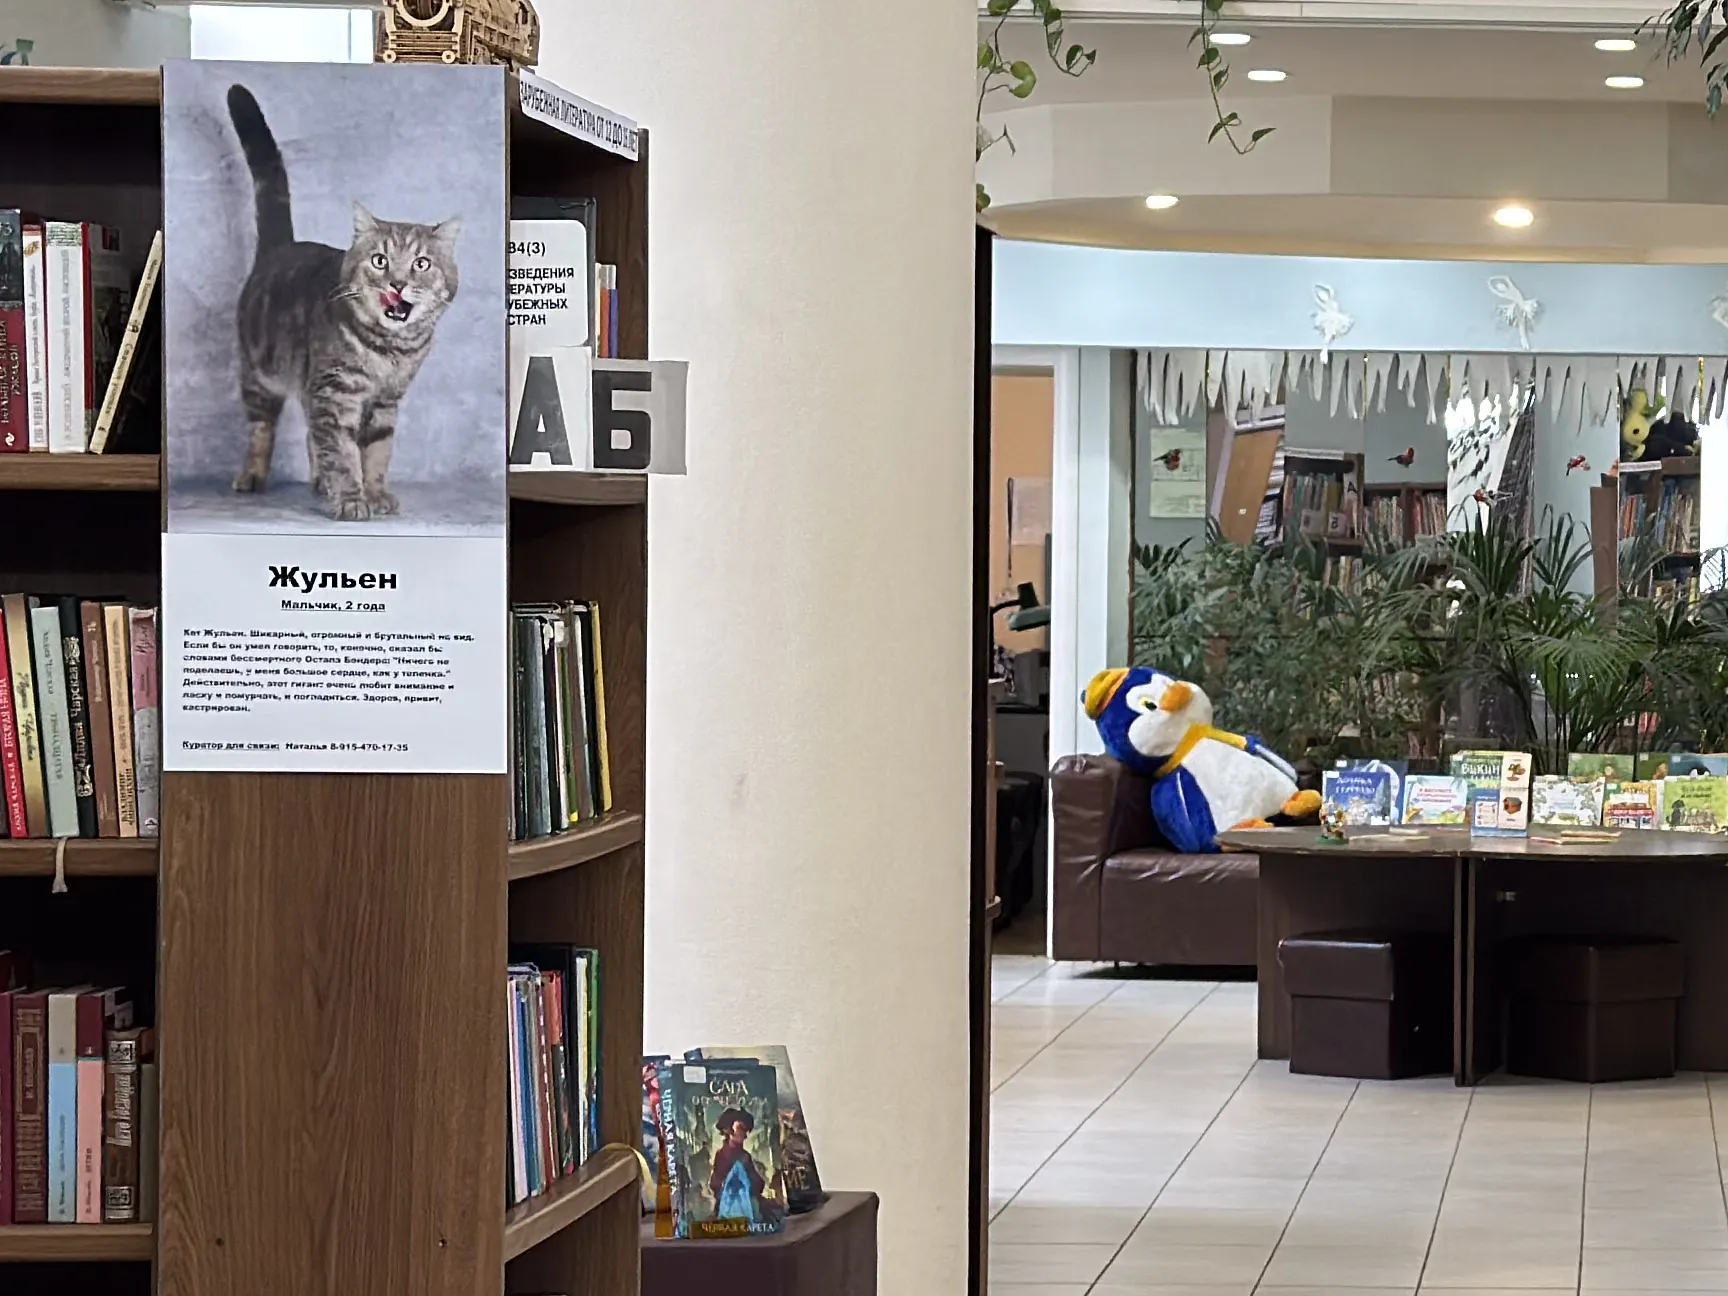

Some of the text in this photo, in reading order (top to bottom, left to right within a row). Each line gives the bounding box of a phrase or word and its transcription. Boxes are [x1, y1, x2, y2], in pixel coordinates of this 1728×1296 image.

[509, 356, 574, 466] А
[592, 369, 652, 470] Б
[268, 565, 399, 593] Жульен
[280, 599, 387, 612] Мальчик, 2 года
